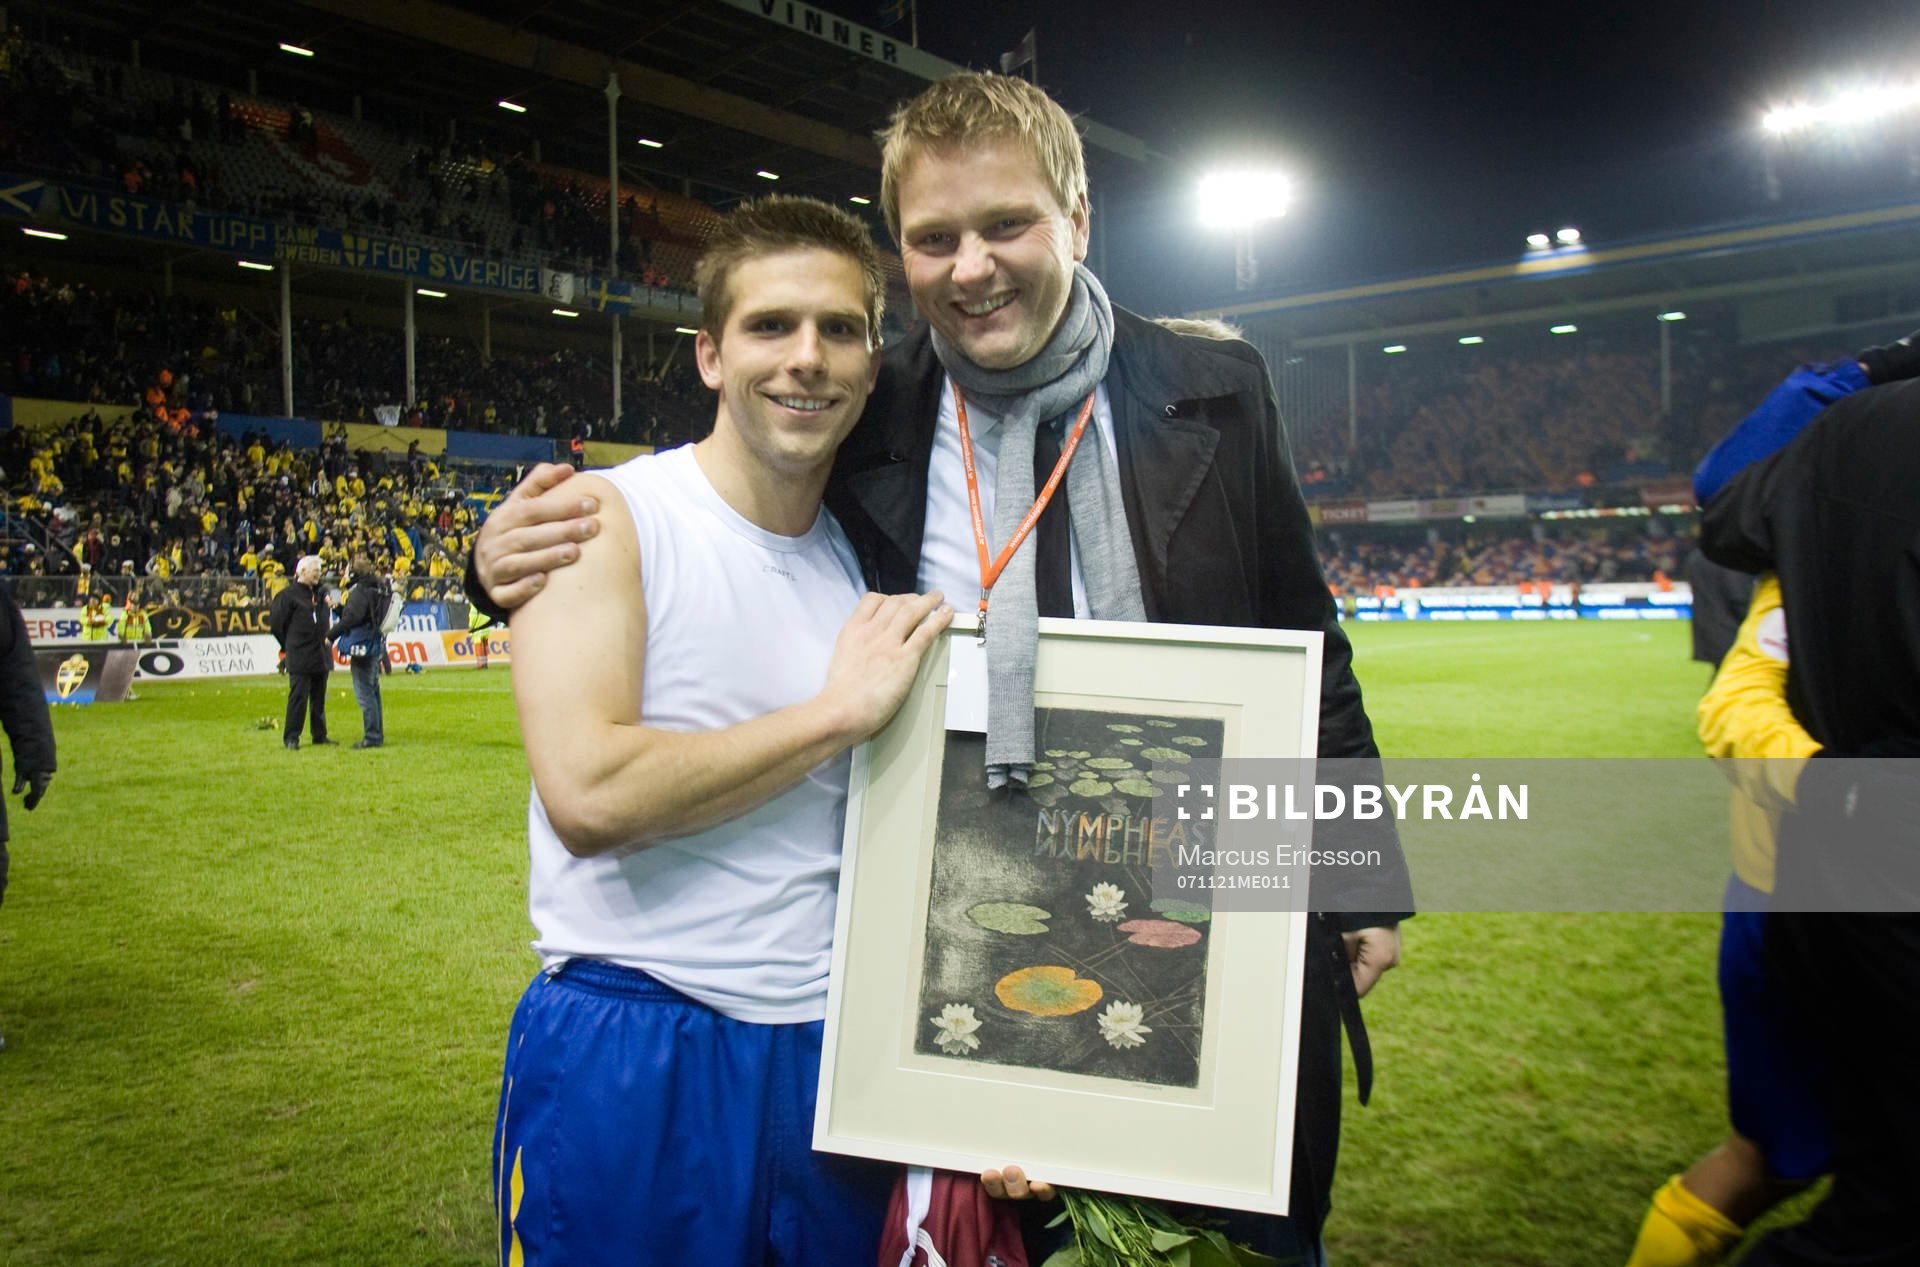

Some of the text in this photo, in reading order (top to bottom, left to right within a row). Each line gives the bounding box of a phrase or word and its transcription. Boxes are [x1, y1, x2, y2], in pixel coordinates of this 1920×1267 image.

[760, 0, 898, 63] VINNER
[59, 186, 97, 223] VI
[209, 217, 267, 249] UPP
[427, 249, 539, 291] SVERIGE
[195, 642, 254, 656] SAUNA
[199, 659, 255, 673] STEAM
